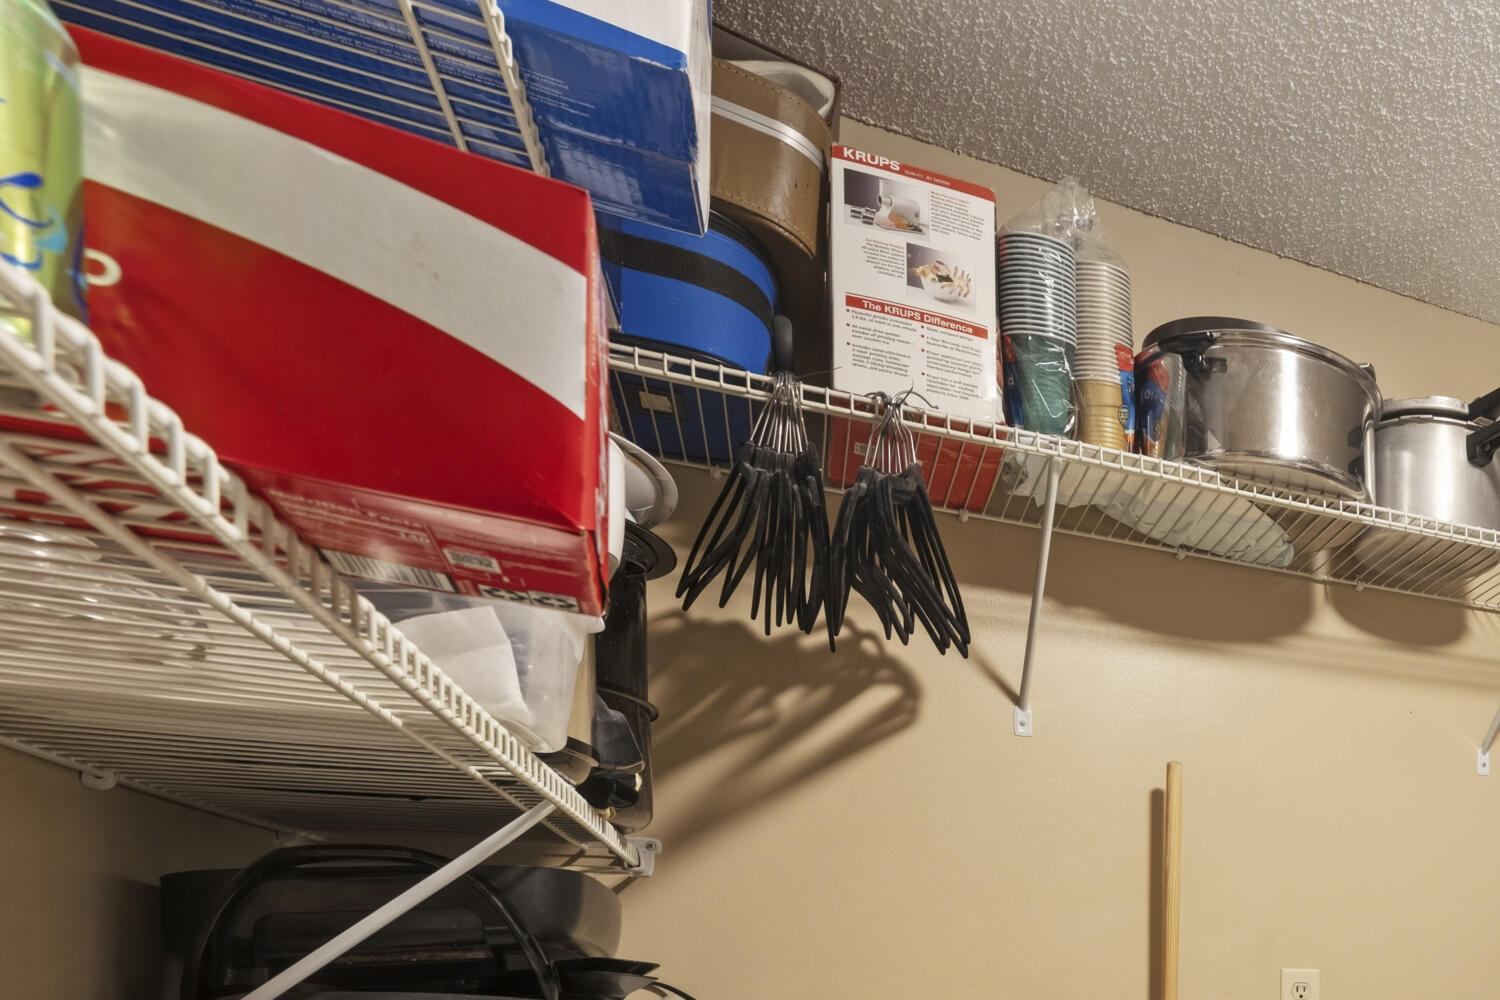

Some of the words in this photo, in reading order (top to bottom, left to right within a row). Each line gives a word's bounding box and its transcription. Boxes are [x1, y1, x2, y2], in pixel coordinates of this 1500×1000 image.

[843, 147, 900, 171] KRUPS
[862, 300, 881, 312] The
[884, 303, 921, 320] KRUPS
[924, 314, 973, 334] Difference
